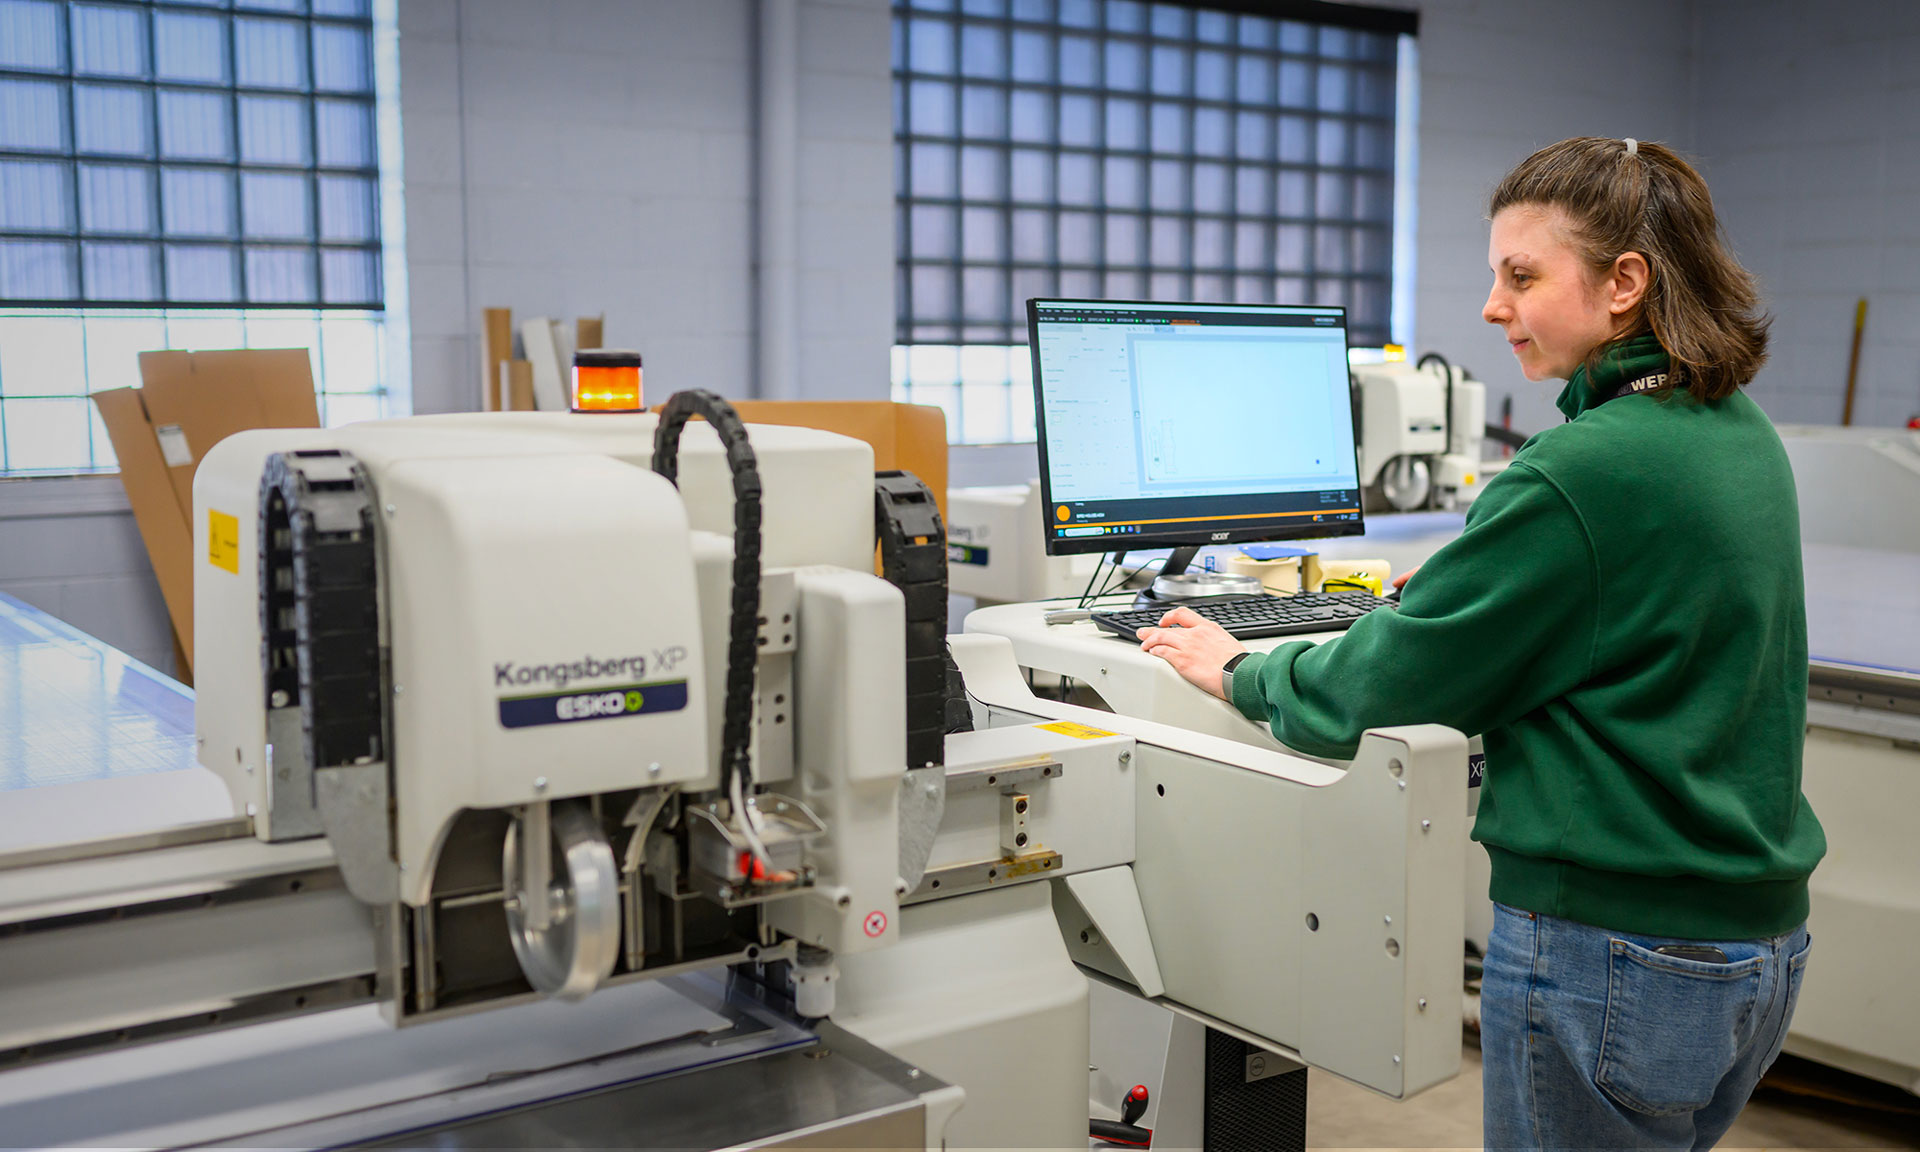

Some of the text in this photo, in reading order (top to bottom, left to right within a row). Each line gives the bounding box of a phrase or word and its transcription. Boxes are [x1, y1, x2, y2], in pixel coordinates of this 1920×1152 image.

[1211, 532, 1230, 541] acer
[493, 646, 687, 687] Kongsberg XP
[556, 691, 625, 720] ESKO
